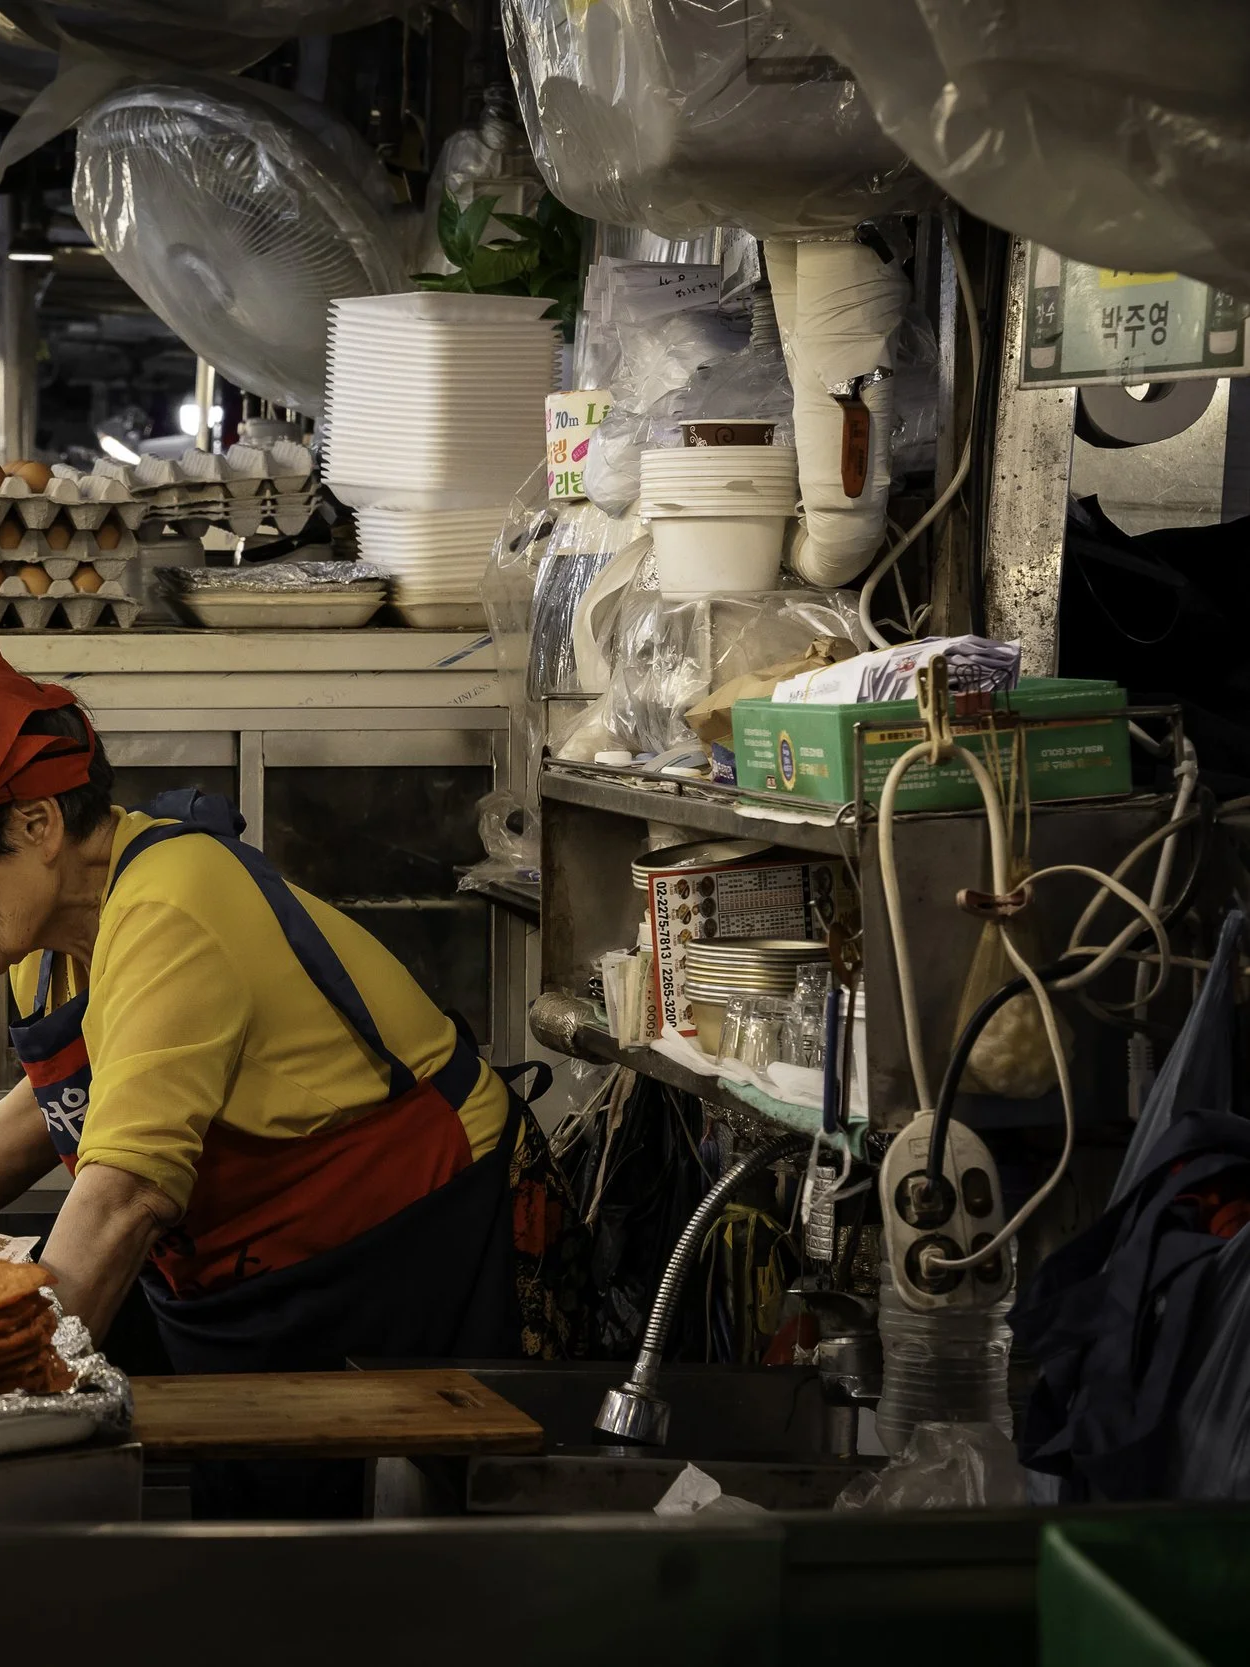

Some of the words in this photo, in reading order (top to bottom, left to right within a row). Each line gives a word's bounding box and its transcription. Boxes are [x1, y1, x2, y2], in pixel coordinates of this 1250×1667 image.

[1102, 300, 1169, 350] 박주영
[1041, 748, 1065, 757] GOLD
[1066, 747, 1083, 755] ACE
[656, 881, 672, 960] 02-2275-7813
[646, 1005, 656, 1038] 5000
